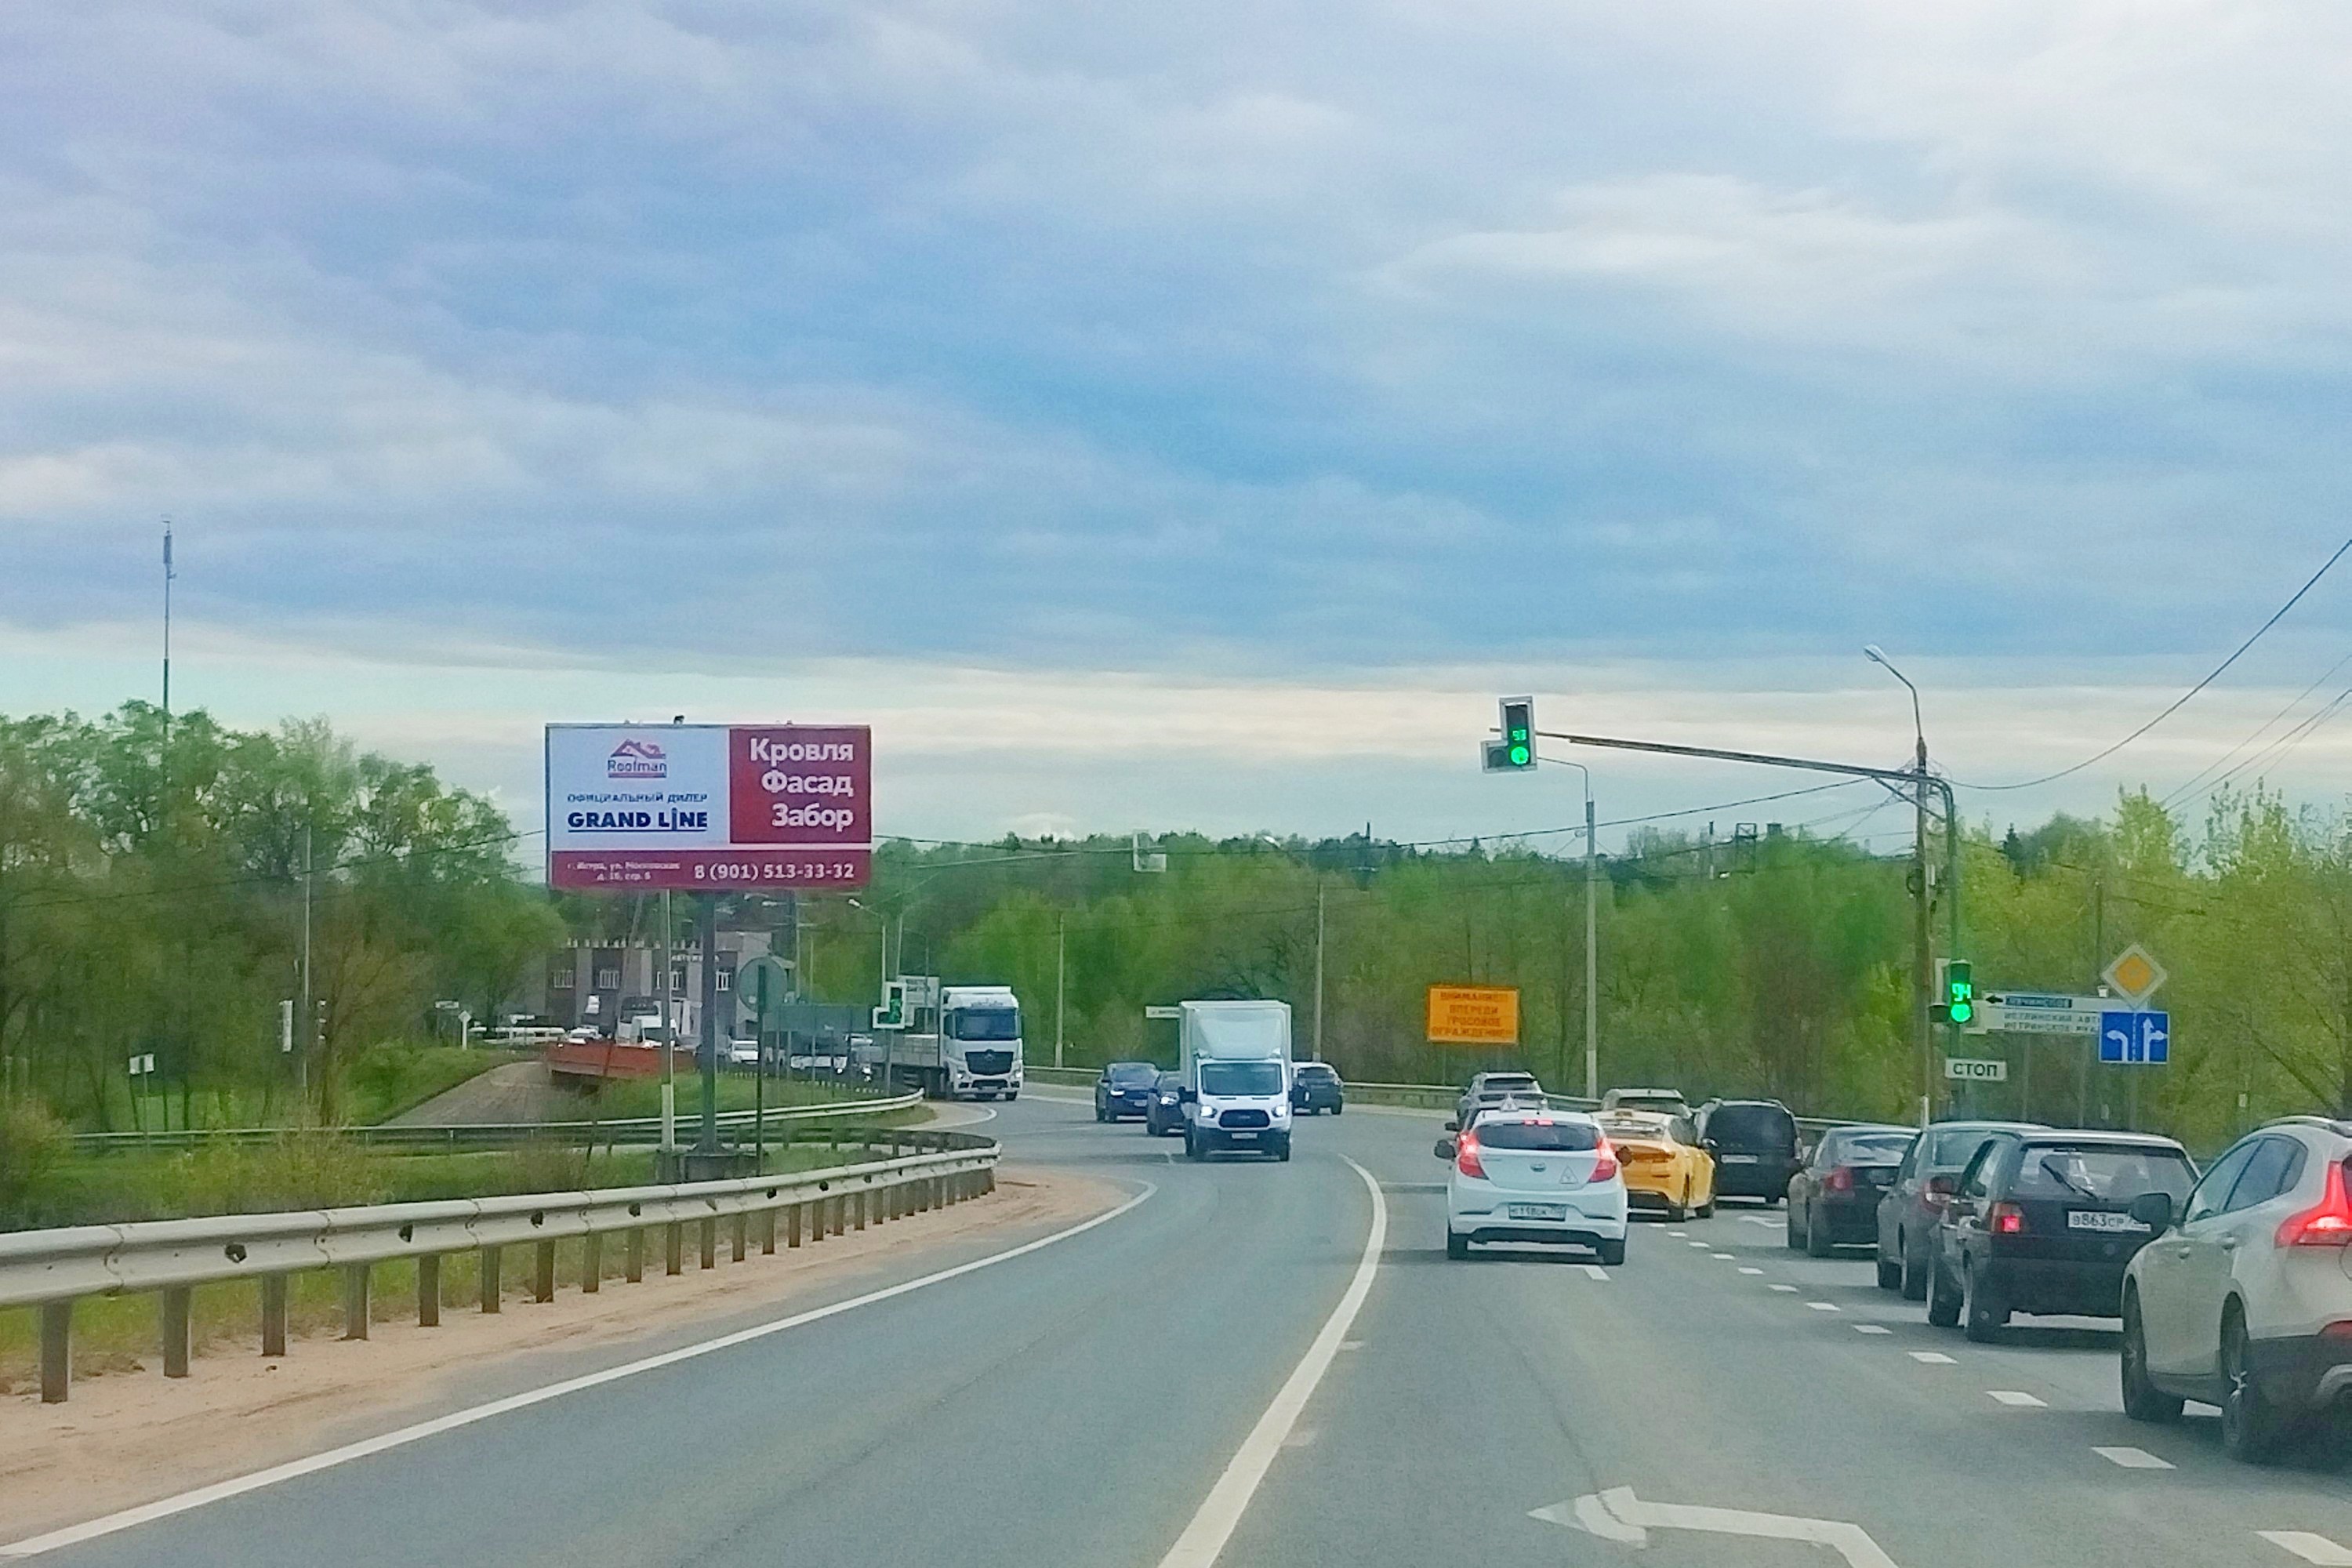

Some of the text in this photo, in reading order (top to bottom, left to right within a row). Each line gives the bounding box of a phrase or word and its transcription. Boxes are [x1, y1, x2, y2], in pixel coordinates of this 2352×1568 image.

[750, 738, 854, 767] Кровля
[608, 758, 666, 772] Roofman
[761, 769, 854, 797] Фасад
[568, 792, 707, 804] ОФИЦИАЛЬНЫЙ ДИЛЕР
[568, 811, 651, 828] GRAND
[771, 803, 854, 833] Забор
[694, 862, 855, 881] 8 (901) 513-33-32
[1953, 1063, 1998, 1076] СТОП
